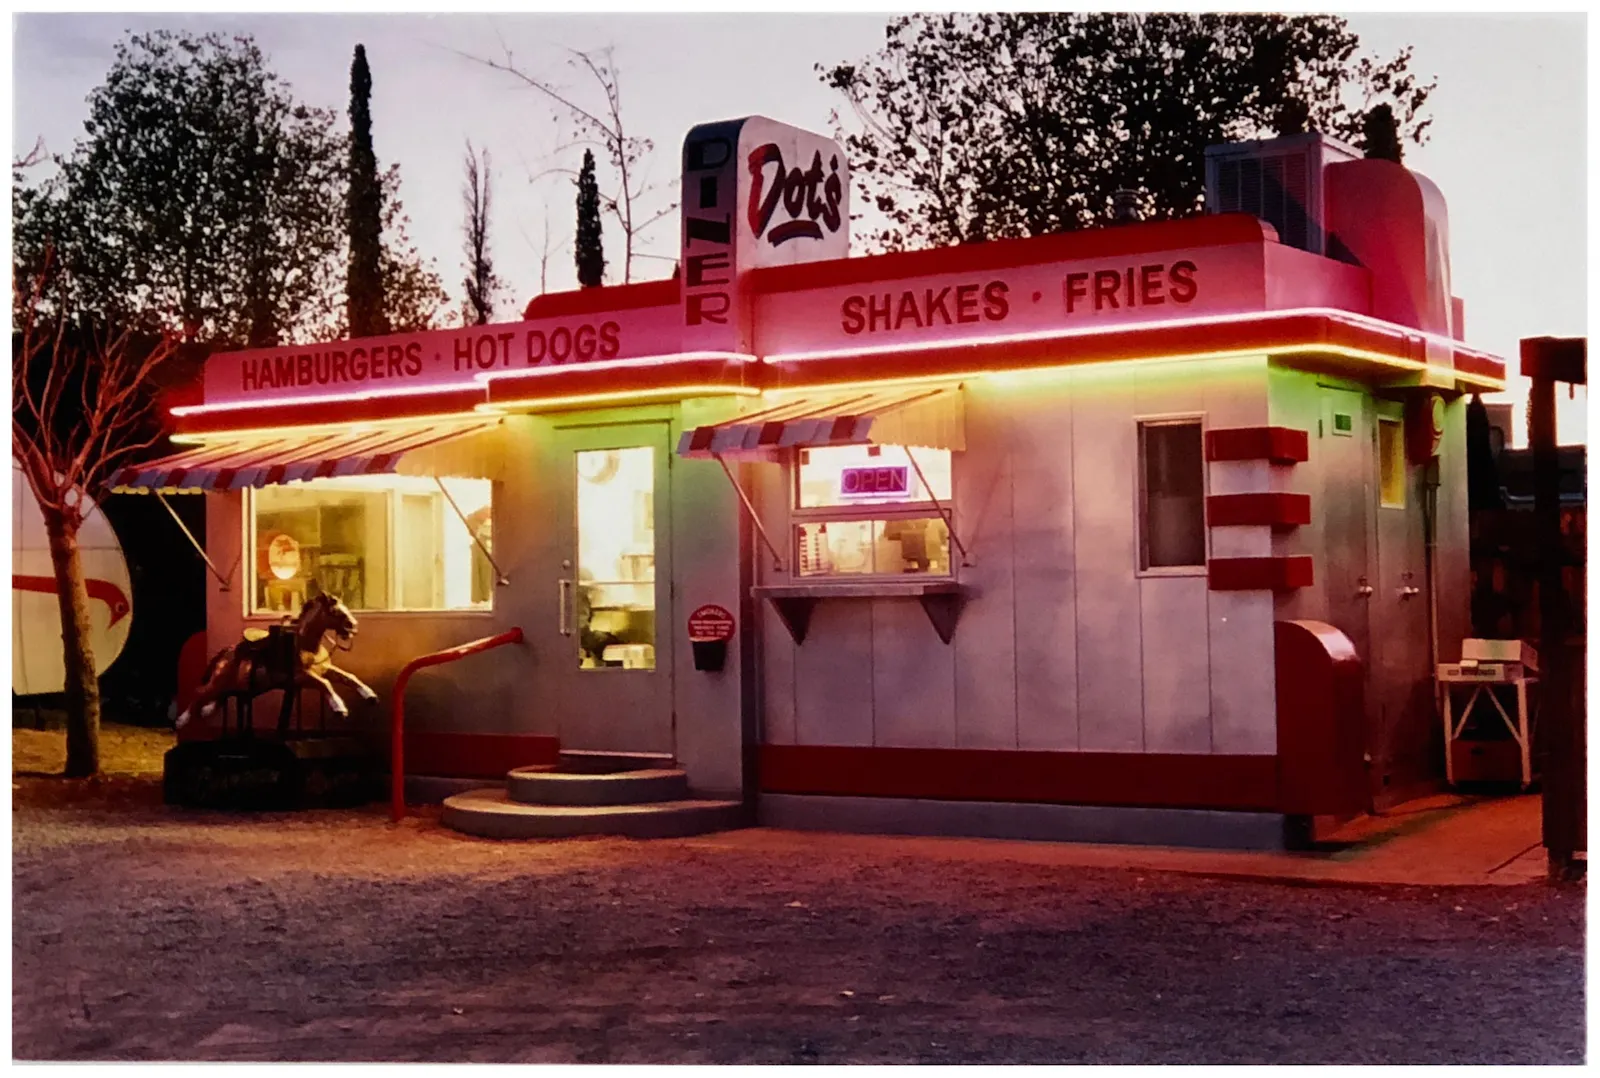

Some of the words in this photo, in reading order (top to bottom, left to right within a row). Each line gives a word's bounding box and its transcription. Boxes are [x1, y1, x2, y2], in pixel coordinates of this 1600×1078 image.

[747, 142, 842, 240] Dot's
[685, 136, 732, 327] DINER
[841, 280, 1010, 335] SHAKES
[1065, 260, 1198, 313] FRIES
[241, 342, 422, 391] HAMBURGERS
[453, 332, 515, 371] HOT
[526, 320, 621, 363] DOGS
[843, 467, 907, 493] OPEN
